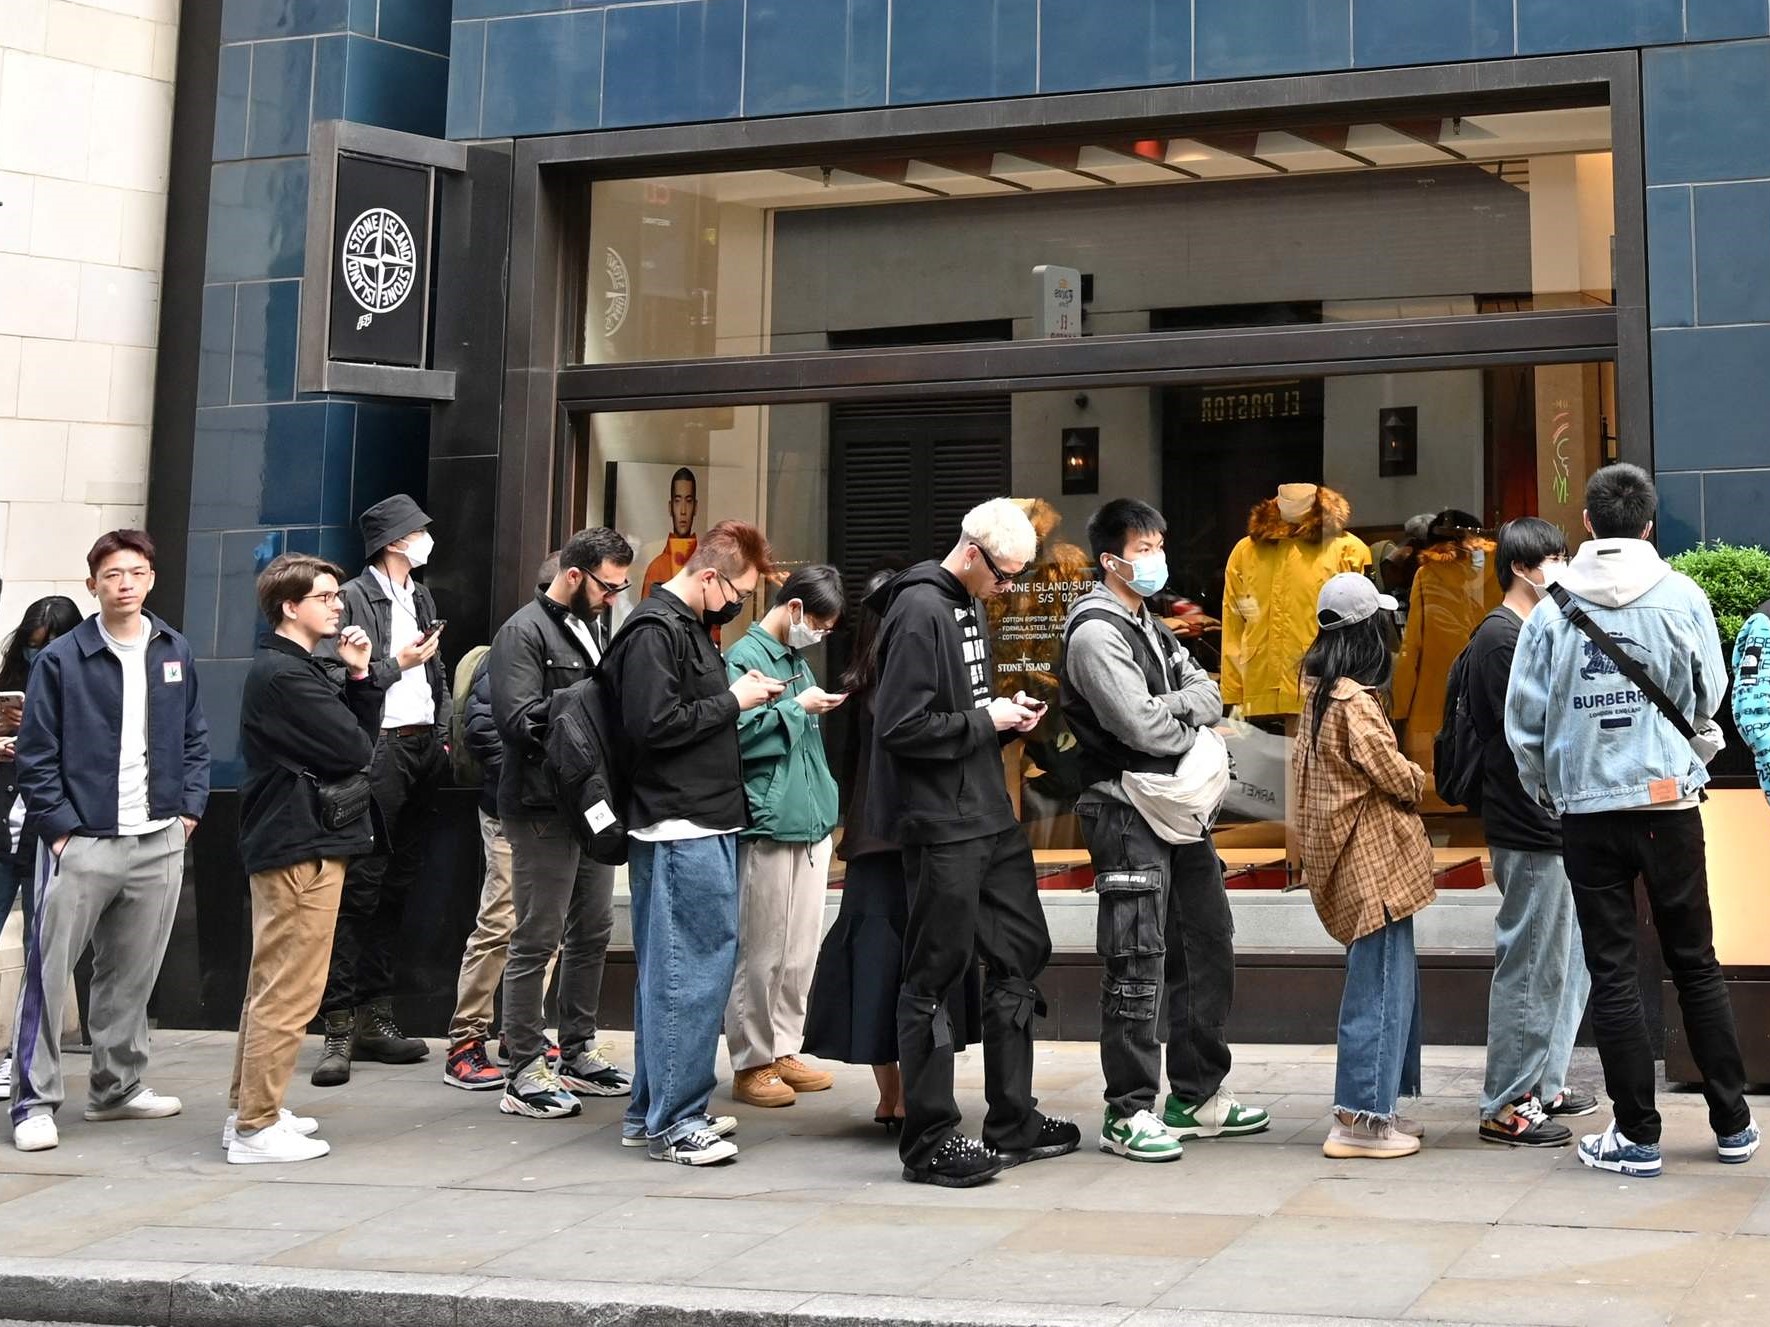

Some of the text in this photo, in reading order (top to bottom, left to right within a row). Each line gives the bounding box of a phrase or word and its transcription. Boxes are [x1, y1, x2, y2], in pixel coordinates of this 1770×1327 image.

[348, 214, 412, 261] STONE ISLAND
[347, 260, 411, 307] STONE ISLAND
[1038, 593, 1054, 603] S/S
[1002, 616, 1024, 624] COTTON
[1024, 615, 1048, 623] RIPSTOP
[997, 662, 1051, 673] STONE ISLAND
[1573, 690, 1650, 710] BURBERR
[1589, 707, 1642, 719] LONDON ENGLAND
